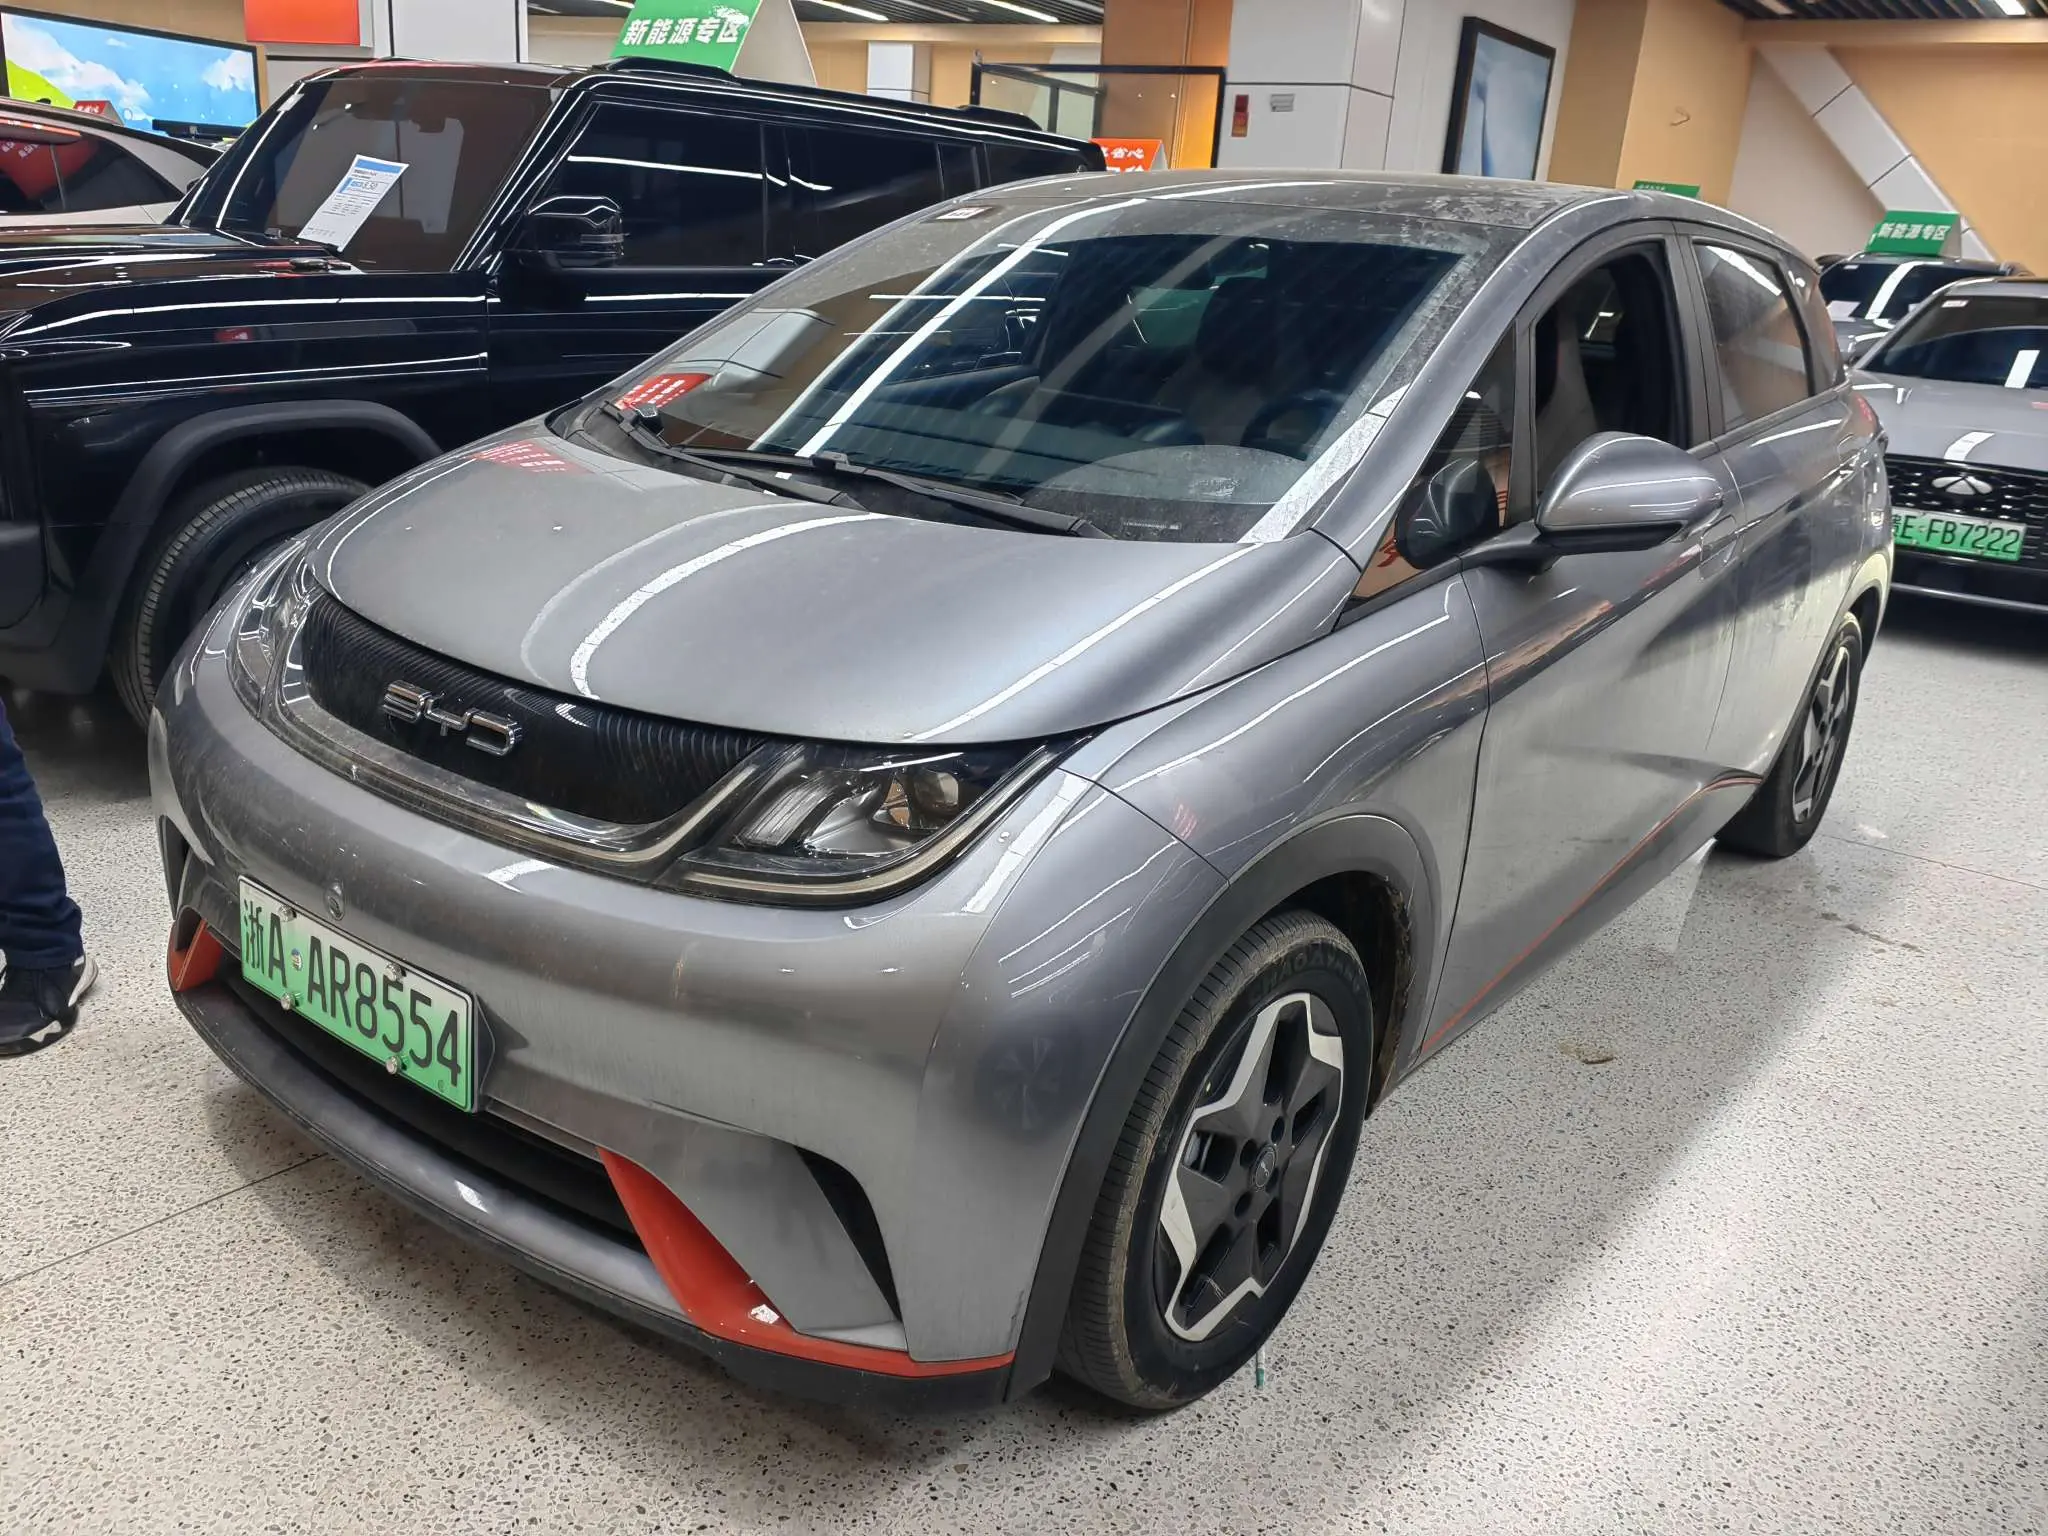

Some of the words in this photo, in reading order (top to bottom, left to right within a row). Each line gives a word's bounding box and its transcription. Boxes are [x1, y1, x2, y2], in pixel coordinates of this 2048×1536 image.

[622, 17, 743, 46] 新能源专区
[1926, 518, 2020, 554] FB7222
[383, 680, 519, 756] BYD
